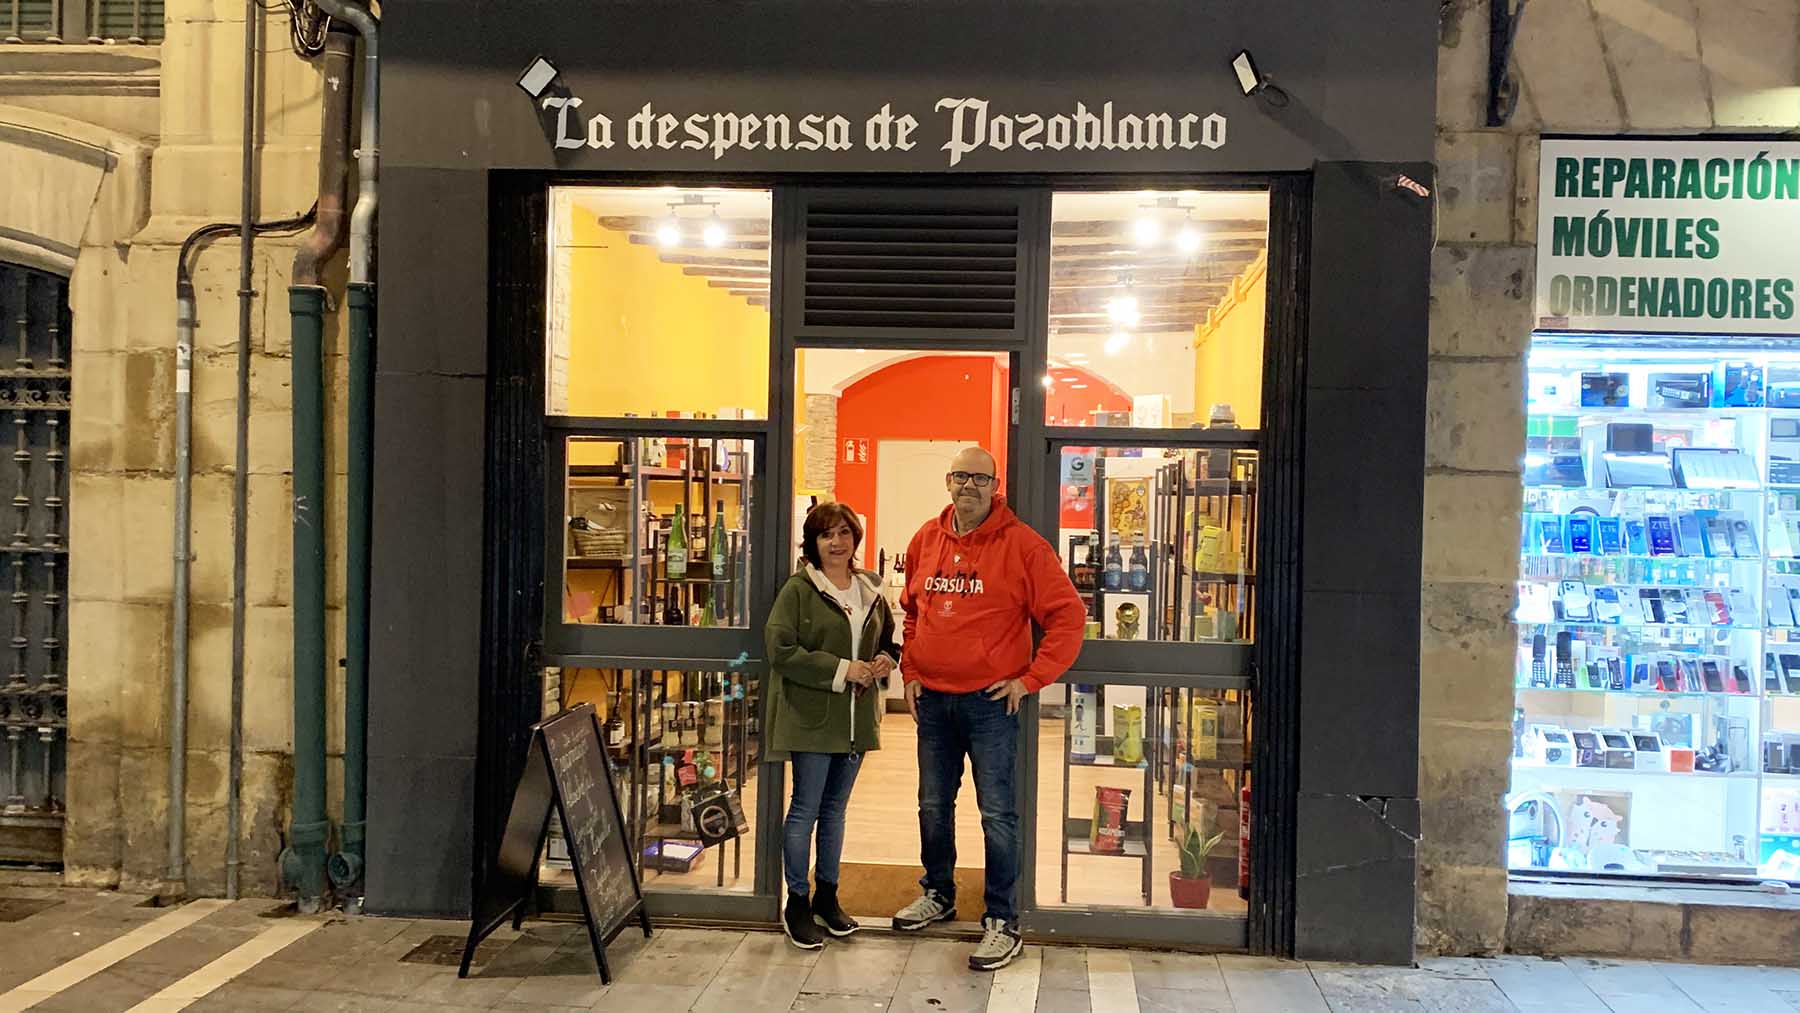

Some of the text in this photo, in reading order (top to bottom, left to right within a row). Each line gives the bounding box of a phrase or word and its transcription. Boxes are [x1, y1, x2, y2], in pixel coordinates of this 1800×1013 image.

[542, 96, 1228, 168] La despensa de Pozoblanco
[1554, 151, 1800, 201] REPARACIÓN
[1552, 209, 1720, 260] MÓVILES
[1550, 274, 1795, 320] ORDENADORES
[1651, 520, 1670, 530] ZTE
